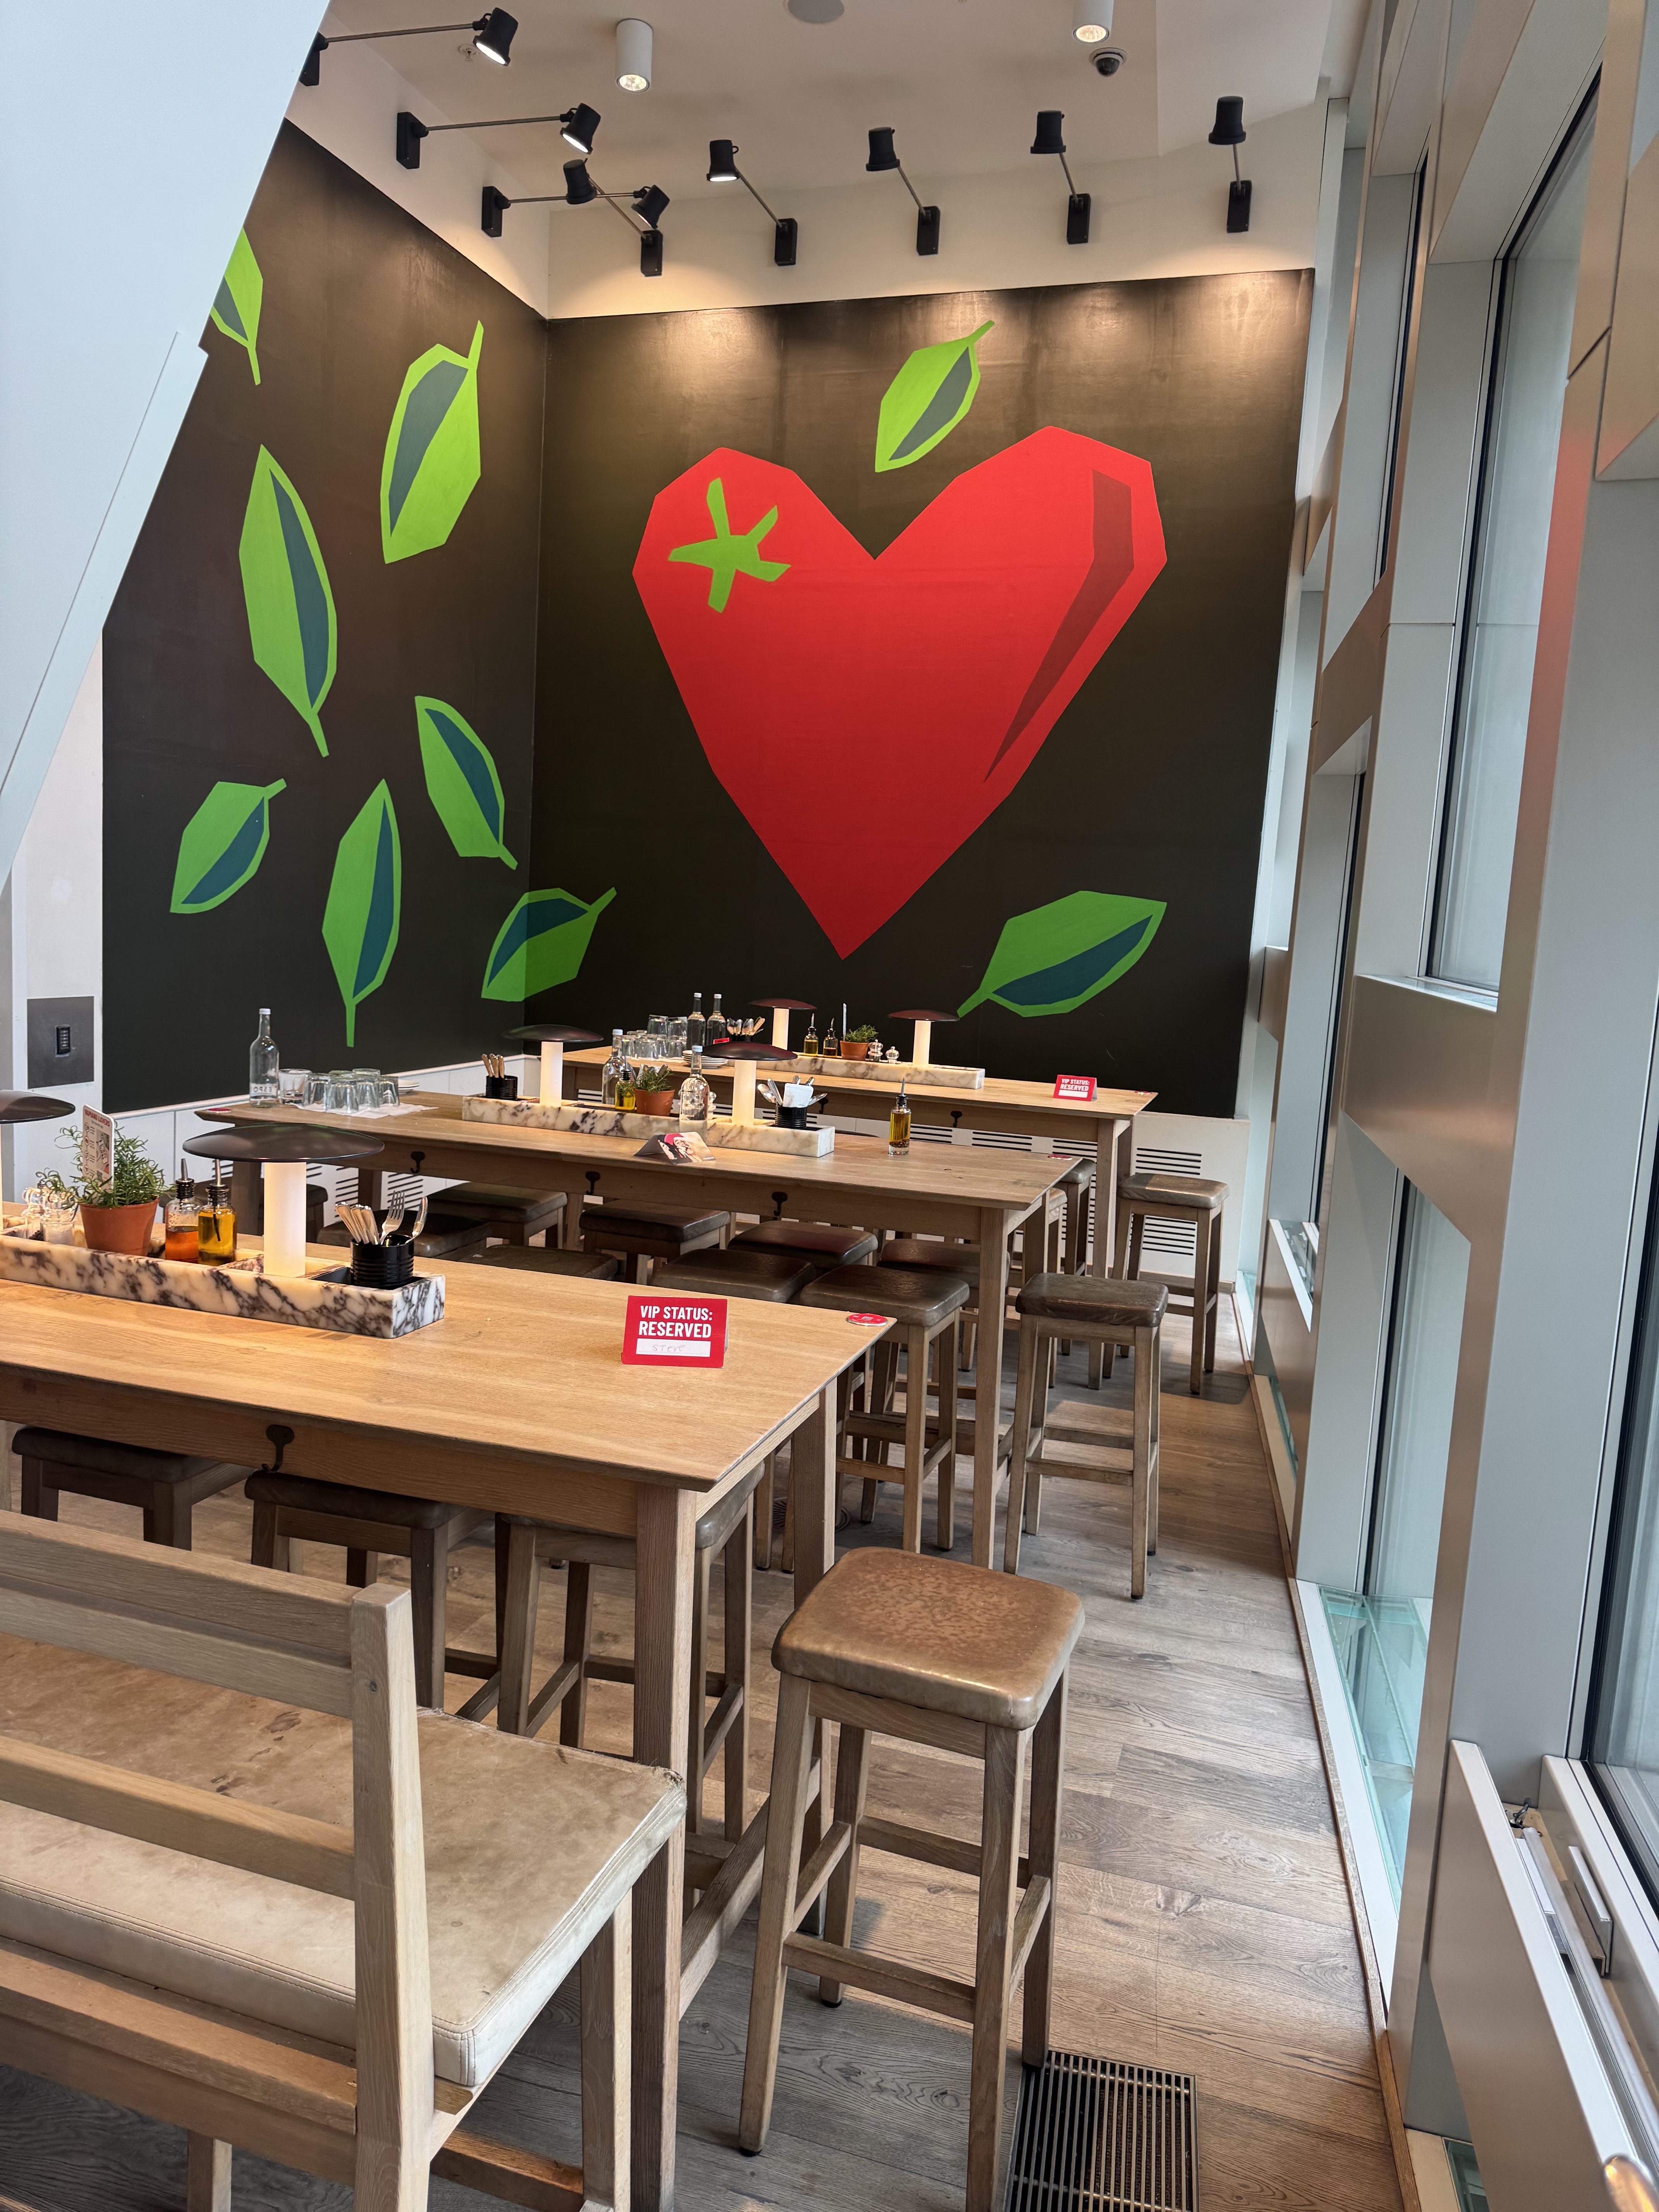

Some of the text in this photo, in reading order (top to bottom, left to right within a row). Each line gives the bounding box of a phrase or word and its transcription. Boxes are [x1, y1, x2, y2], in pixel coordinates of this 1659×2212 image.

[640, 1305, 713, 1321] VIP STATUS:
[639, 1321, 712, 1338] RESERVED
